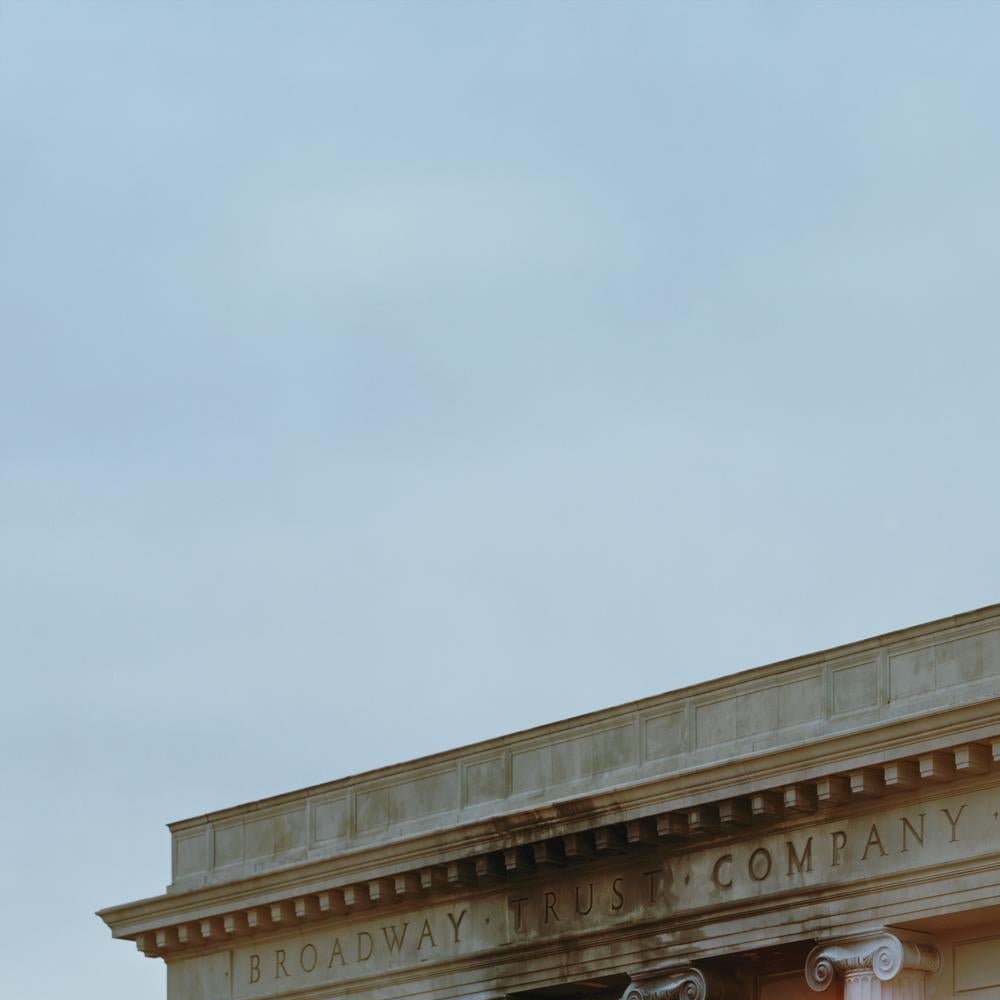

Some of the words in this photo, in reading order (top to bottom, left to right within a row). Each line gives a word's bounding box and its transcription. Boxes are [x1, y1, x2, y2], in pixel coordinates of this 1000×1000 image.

[249, 909, 467, 985] BROADWAY
[511, 869, 662, 934] TRUST
[712, 804, 968, 890] COMPANY
